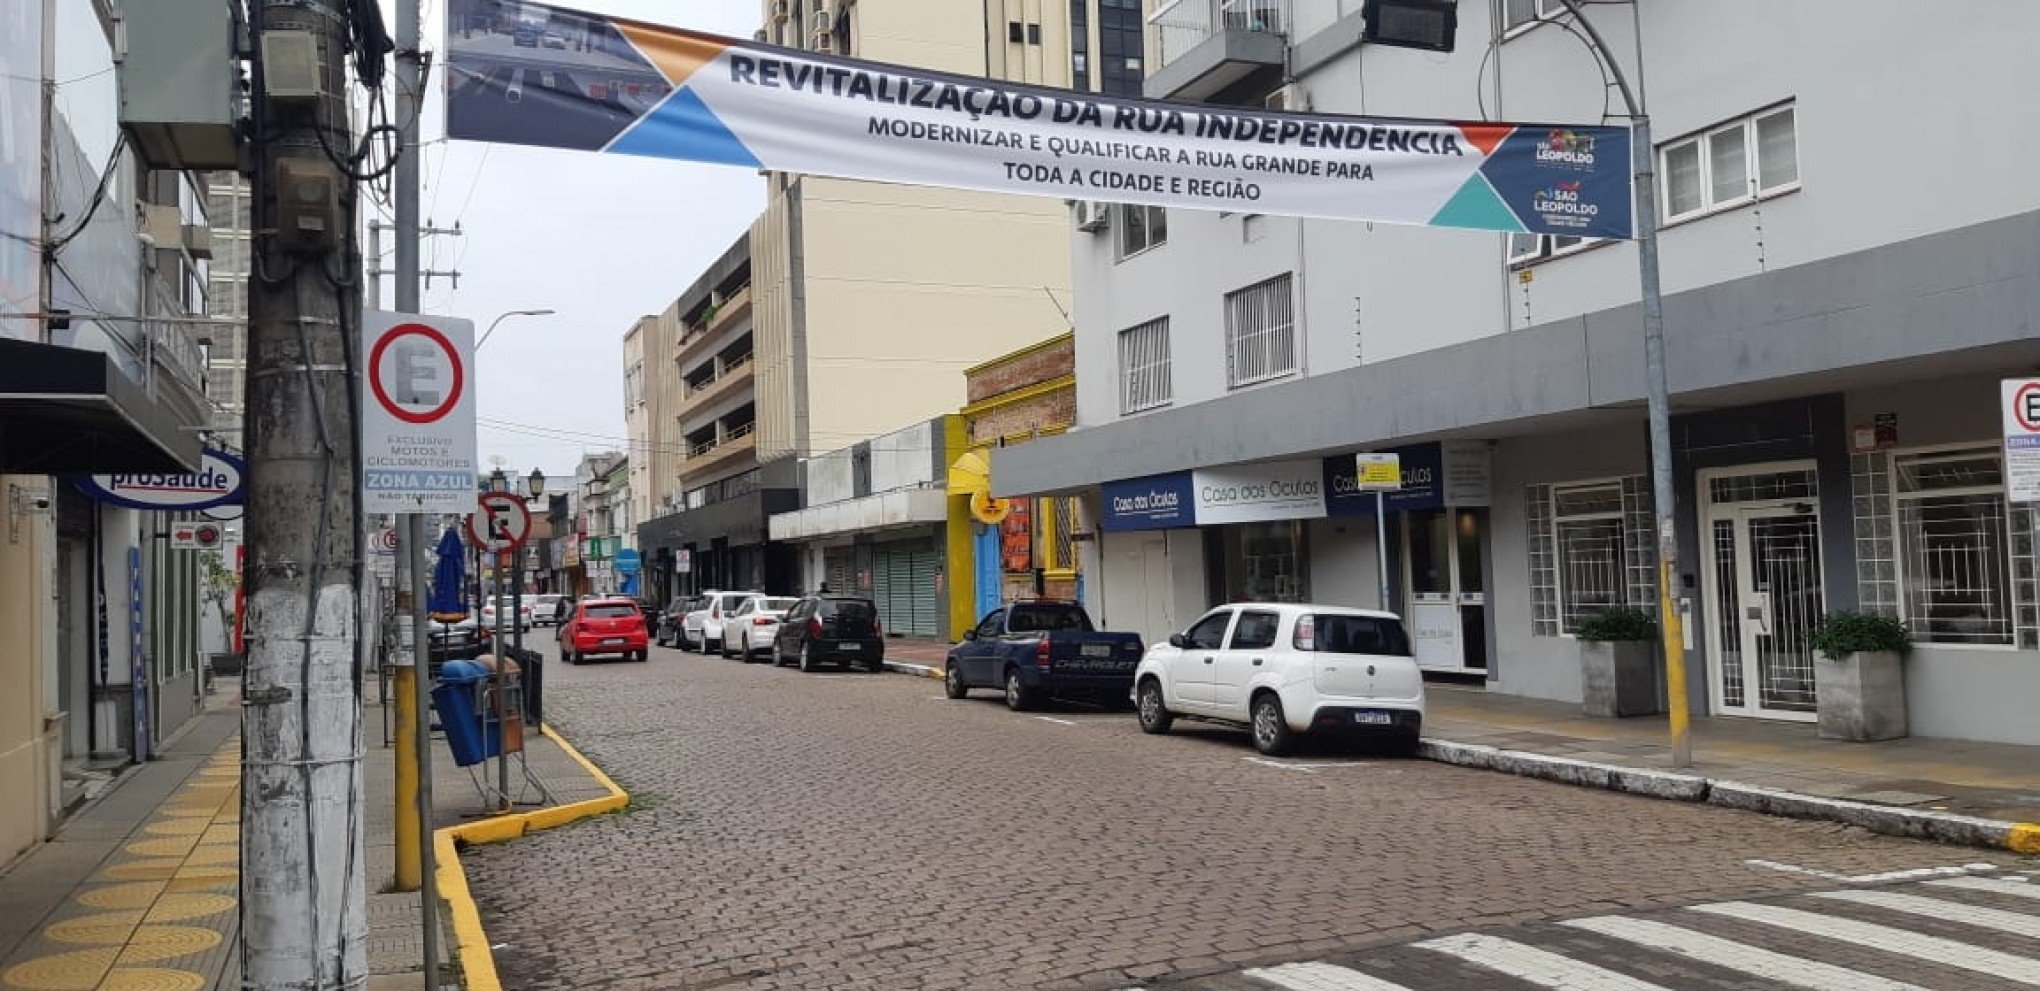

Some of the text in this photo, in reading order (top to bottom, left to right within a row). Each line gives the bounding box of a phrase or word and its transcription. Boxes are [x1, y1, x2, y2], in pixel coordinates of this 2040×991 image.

[1053, 98, 1101, 127] DA
[1113, 106, 1185, 135] RUA
[868, 117, 1374, 181] MODERNIZAR E QUALIFICAR A RUA GRANDE PARA
[1004, 161, 1261, 200] TODA A CIDADE E REGIÃO
[1534, 199, 1599, 215] LEOPOLDO
[396, 345, 440, 406] E
[367, 456, 470, 468] CICLOMOTORES
[390, 446, 438, 456] MOTOS
[367, 473, 473, 489] ZONA AZUL
